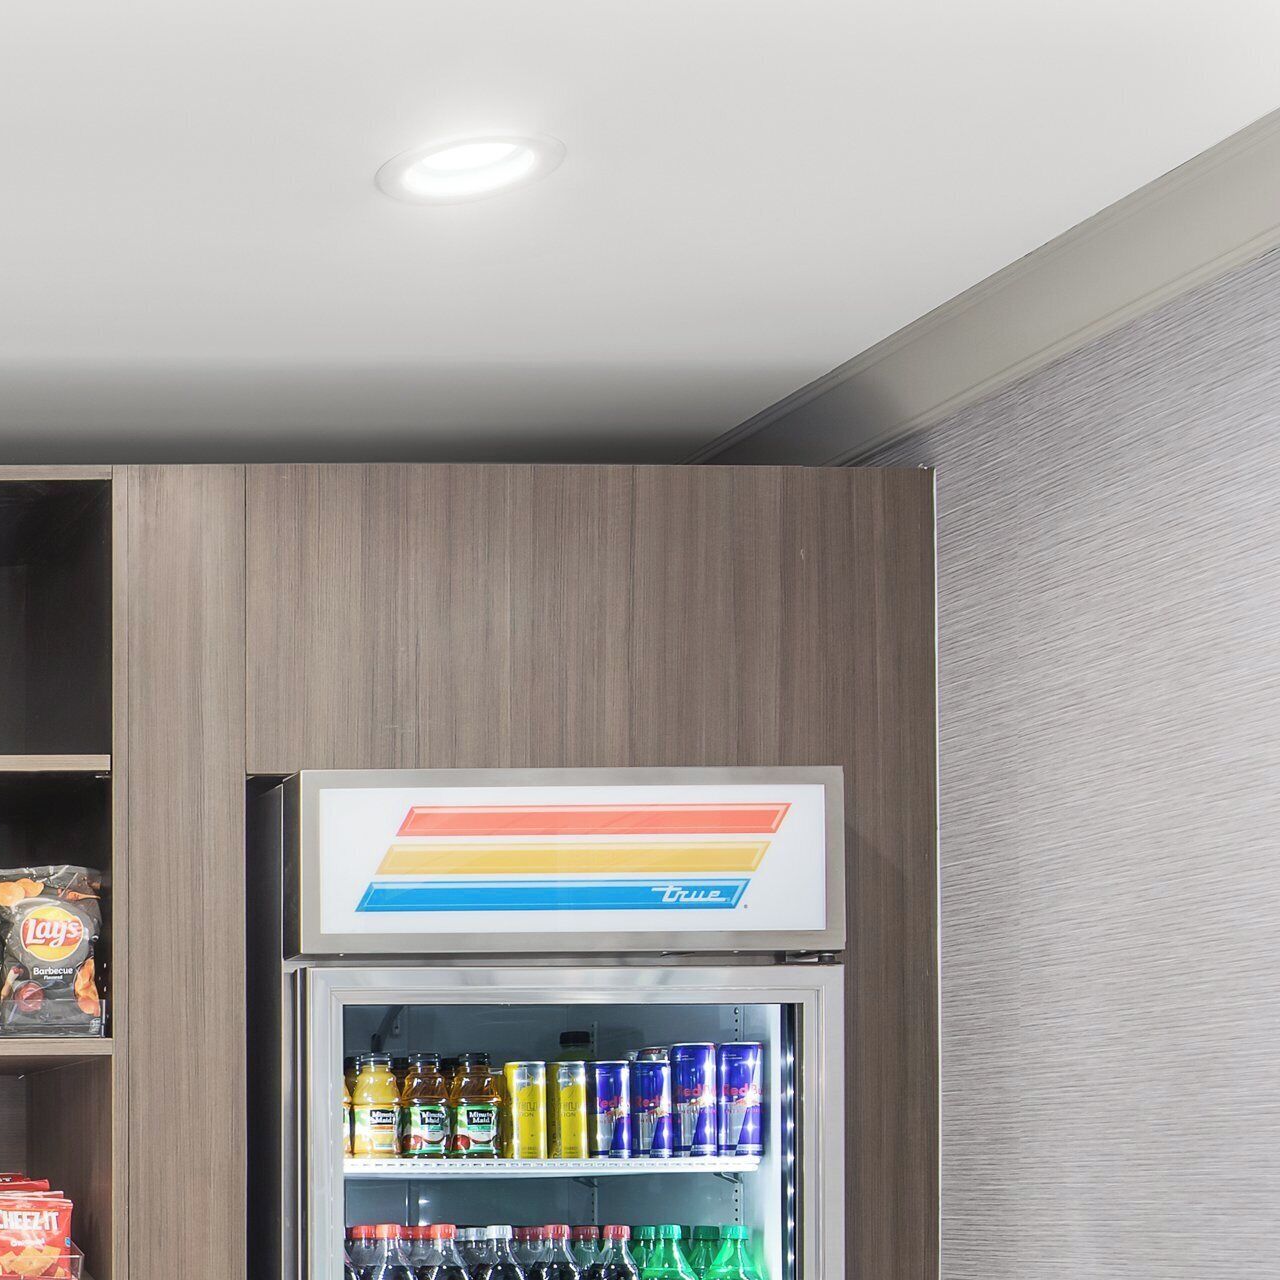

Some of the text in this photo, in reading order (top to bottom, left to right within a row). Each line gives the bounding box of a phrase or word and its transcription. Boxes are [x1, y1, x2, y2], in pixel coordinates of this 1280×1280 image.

[26, 919, 81, 948] Lay's
[33, 967, 73, 976] Barbecue
[371, 1110, 395, 1118] Minute
